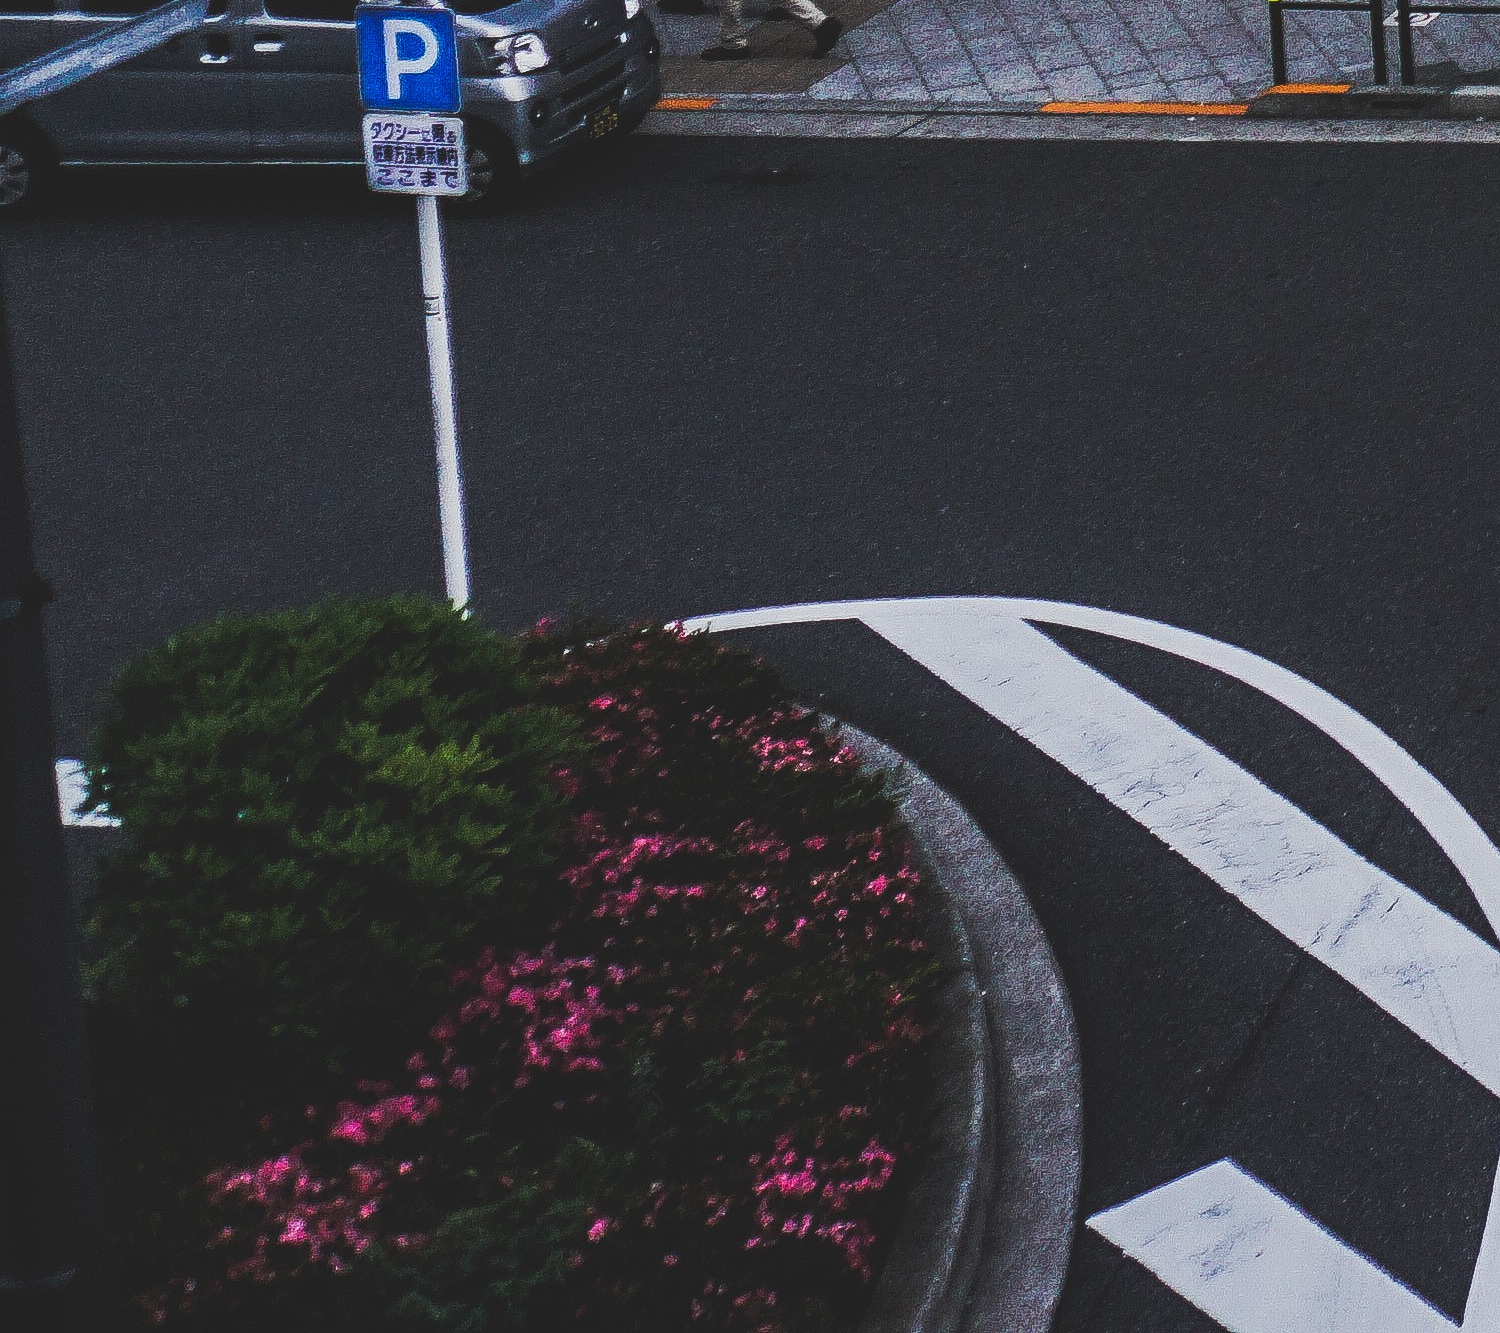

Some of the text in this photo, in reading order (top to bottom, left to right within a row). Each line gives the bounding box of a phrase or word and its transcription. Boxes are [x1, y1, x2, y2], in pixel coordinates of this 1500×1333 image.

[383, 18, 439, 100] P
[376, 168, 460, 190] ここまで
